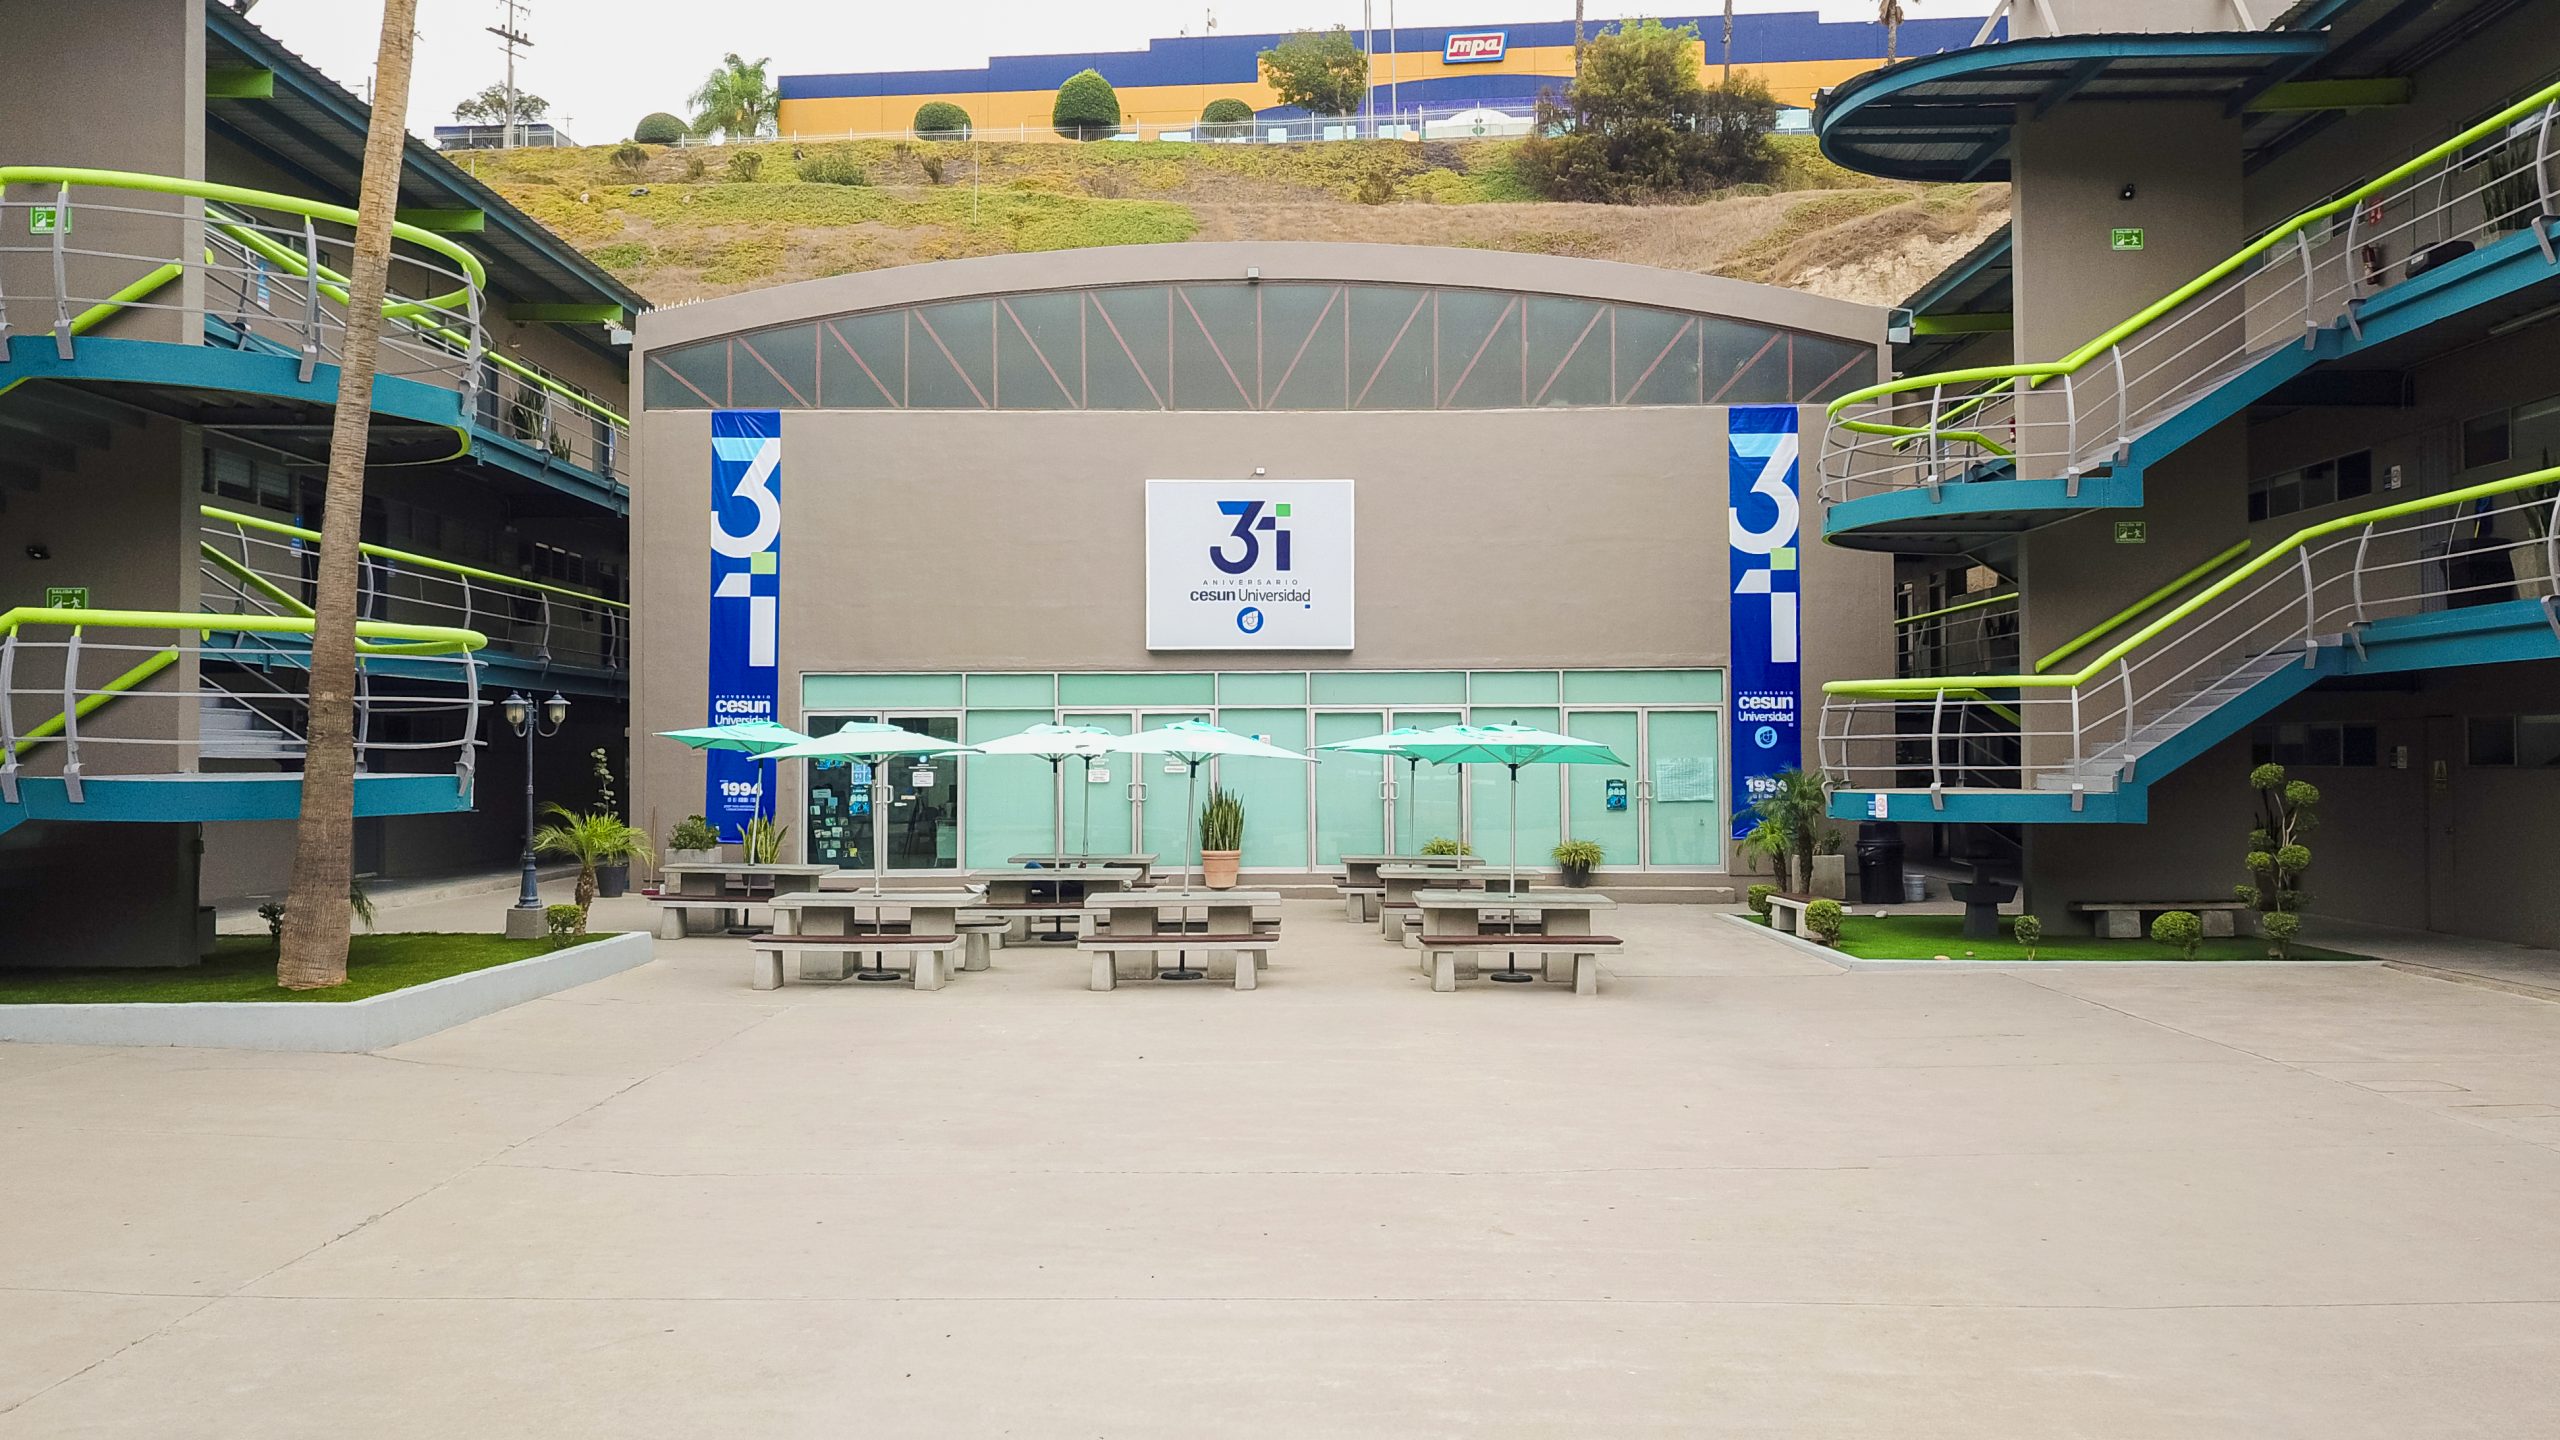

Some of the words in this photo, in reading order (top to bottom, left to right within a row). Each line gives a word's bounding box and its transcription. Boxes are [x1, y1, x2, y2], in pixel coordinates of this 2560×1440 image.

[1450, 38, 1502, 58] mpa
[1190, 590, 1236, 601] cesun
[1238, 588, 1311, 602] Universidad
[715, 699, 771, 713] cesun
[1738, 696, 1794, 709] cesun
[1738, 711, 1794, 722] Universidad
[720, 782, 763, 797] 1994
